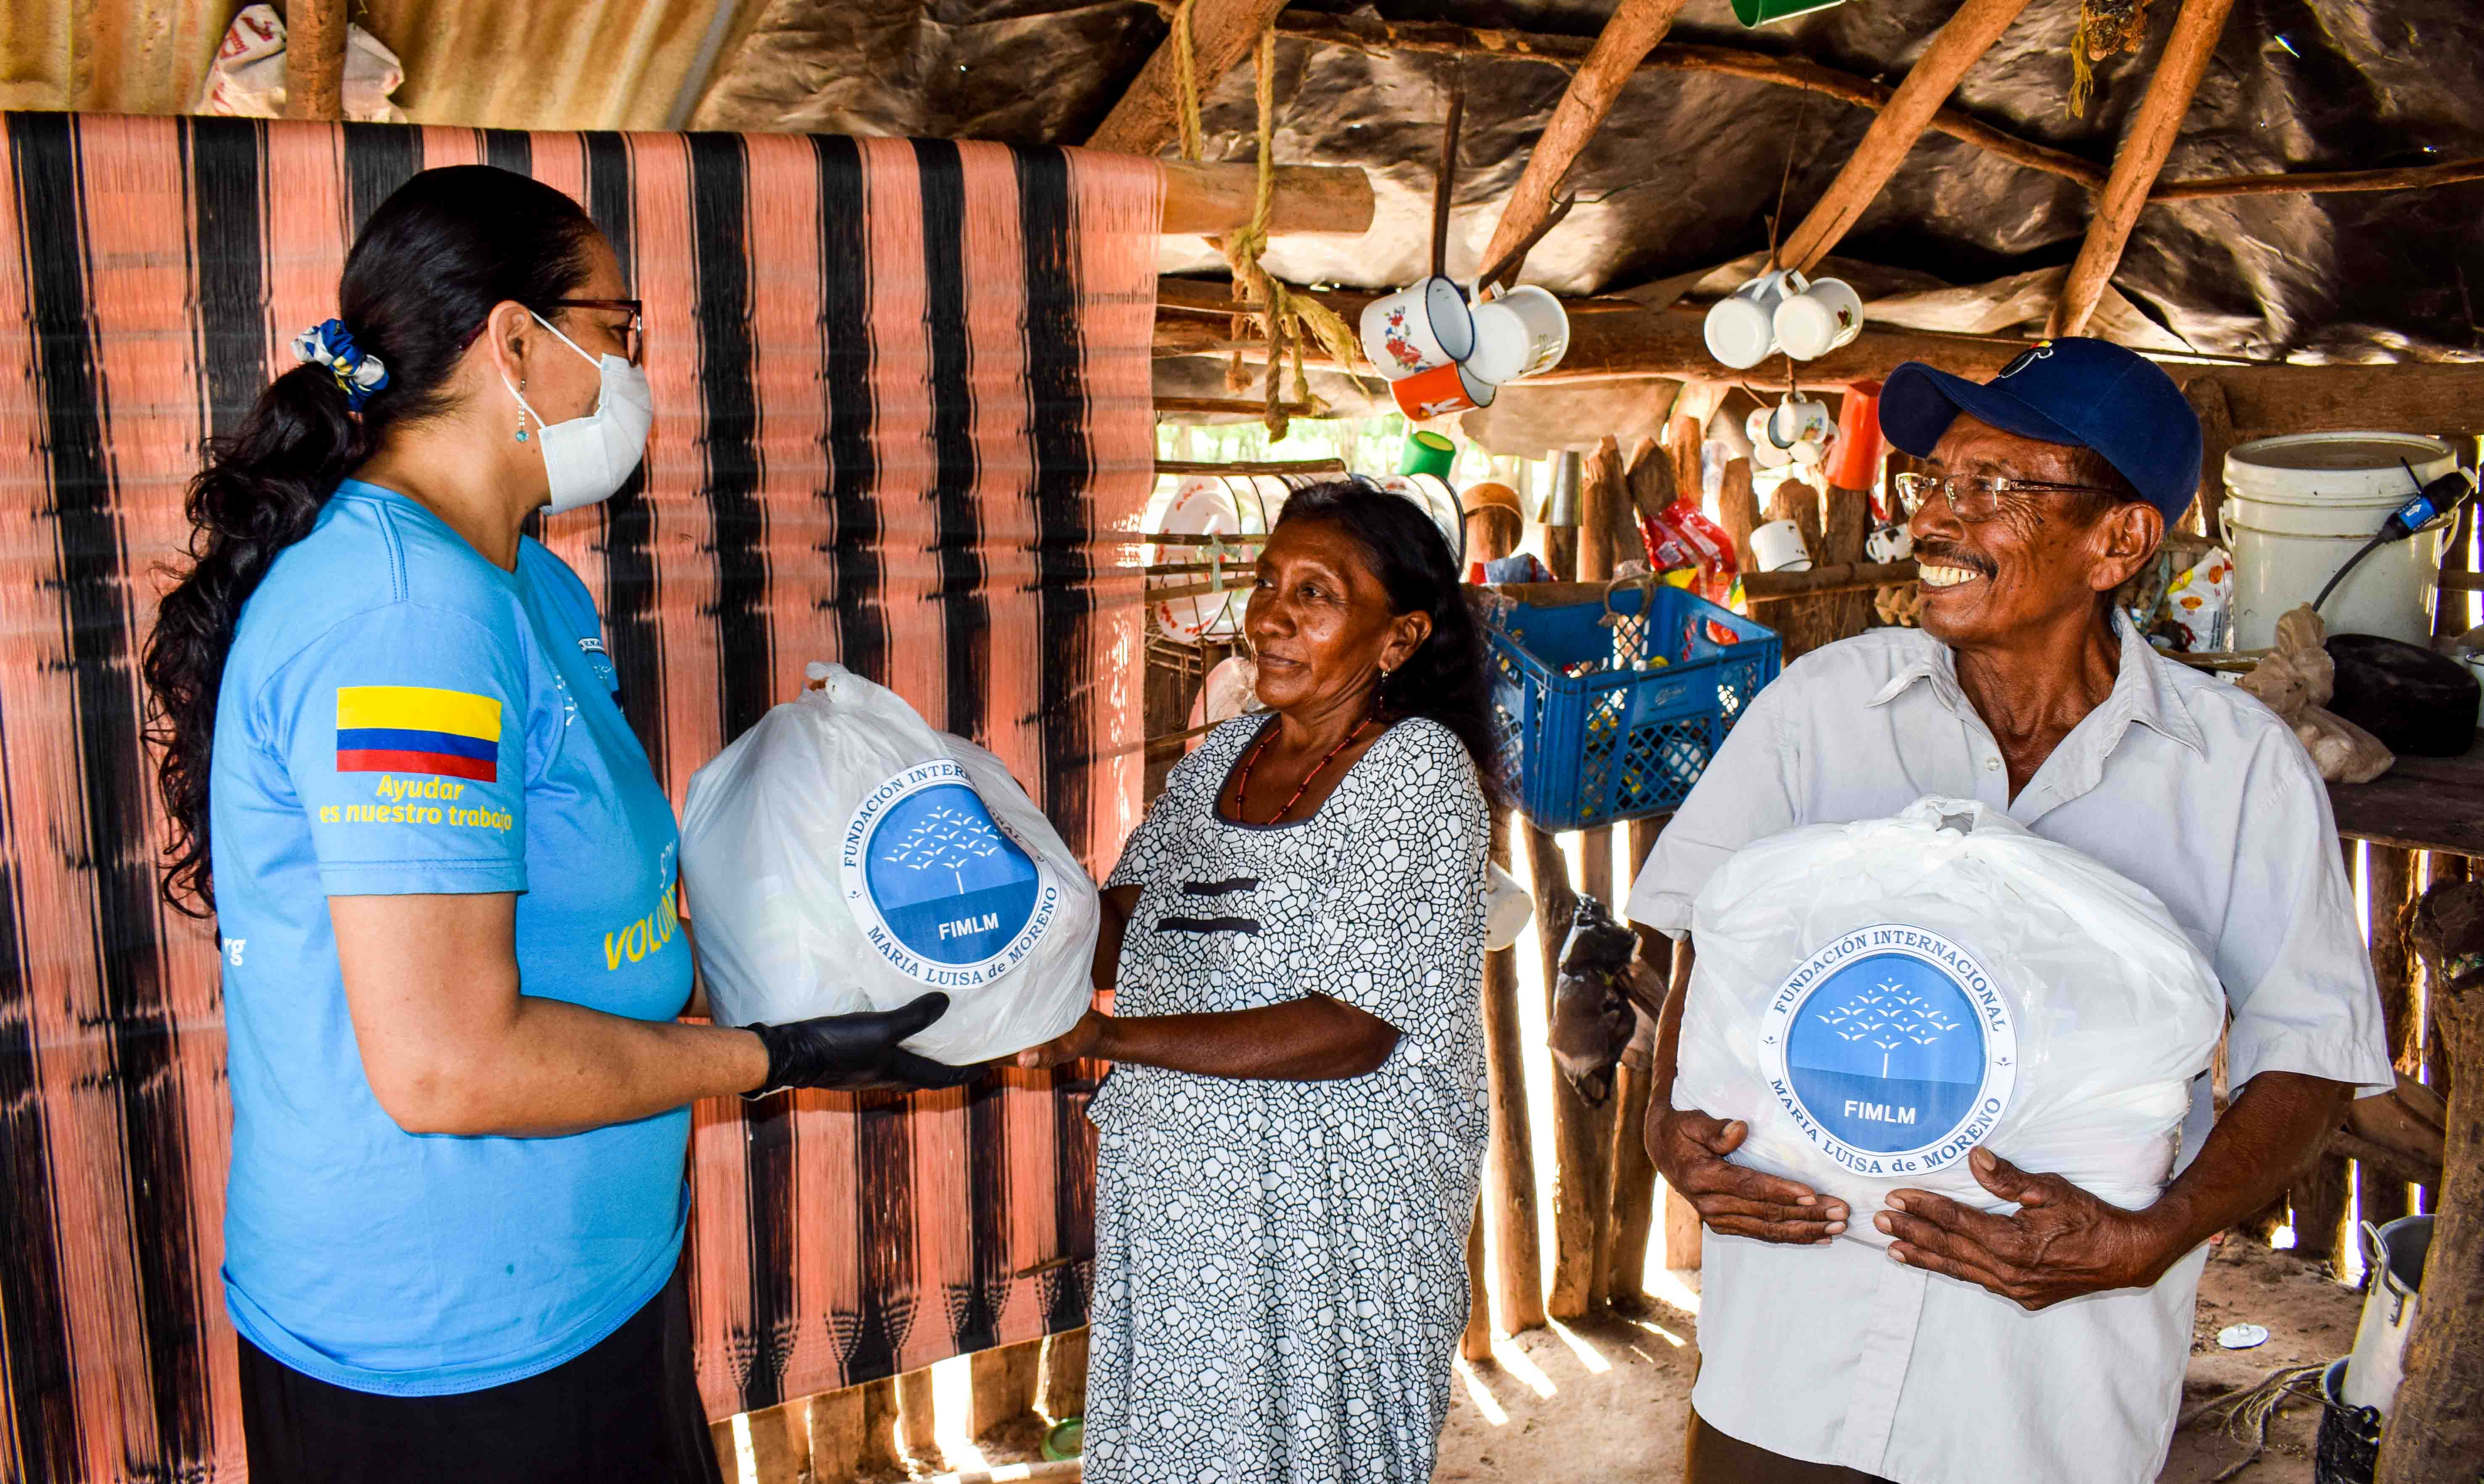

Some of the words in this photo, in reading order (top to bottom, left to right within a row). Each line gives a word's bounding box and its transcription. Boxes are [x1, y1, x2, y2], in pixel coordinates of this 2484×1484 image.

[320, 805, 340, 823] es
[346, 804, 441, 824] nuestro
[449, 805, 512, 833] trabajo
[376, 775, 465, 803] Ayudar
[844, 778, 905, 868] FUNDACIÓN
[867, 925, 919, 977] MARIA
[925, 970, 983, 986] LUISA
[988, 962, 1006, 978] de
[1009, 887, 1057, 965] MORENO
[938, 913, 999, 940] FIMLM
[1773, 935, 1868, 1015] FUNDACIÓN
[1873, 930, 2007, 1032] INTERNACIONAL
[1770, 1078, 1818, 1142] MARIA
[1823, 1140, 1883, 1173] LUISA
[1892, 1158, 1916, 1172] de
[1923, 1097, 2001, 1168] MORENO
[1844, 1099, 1916, 1125] FIMLM
